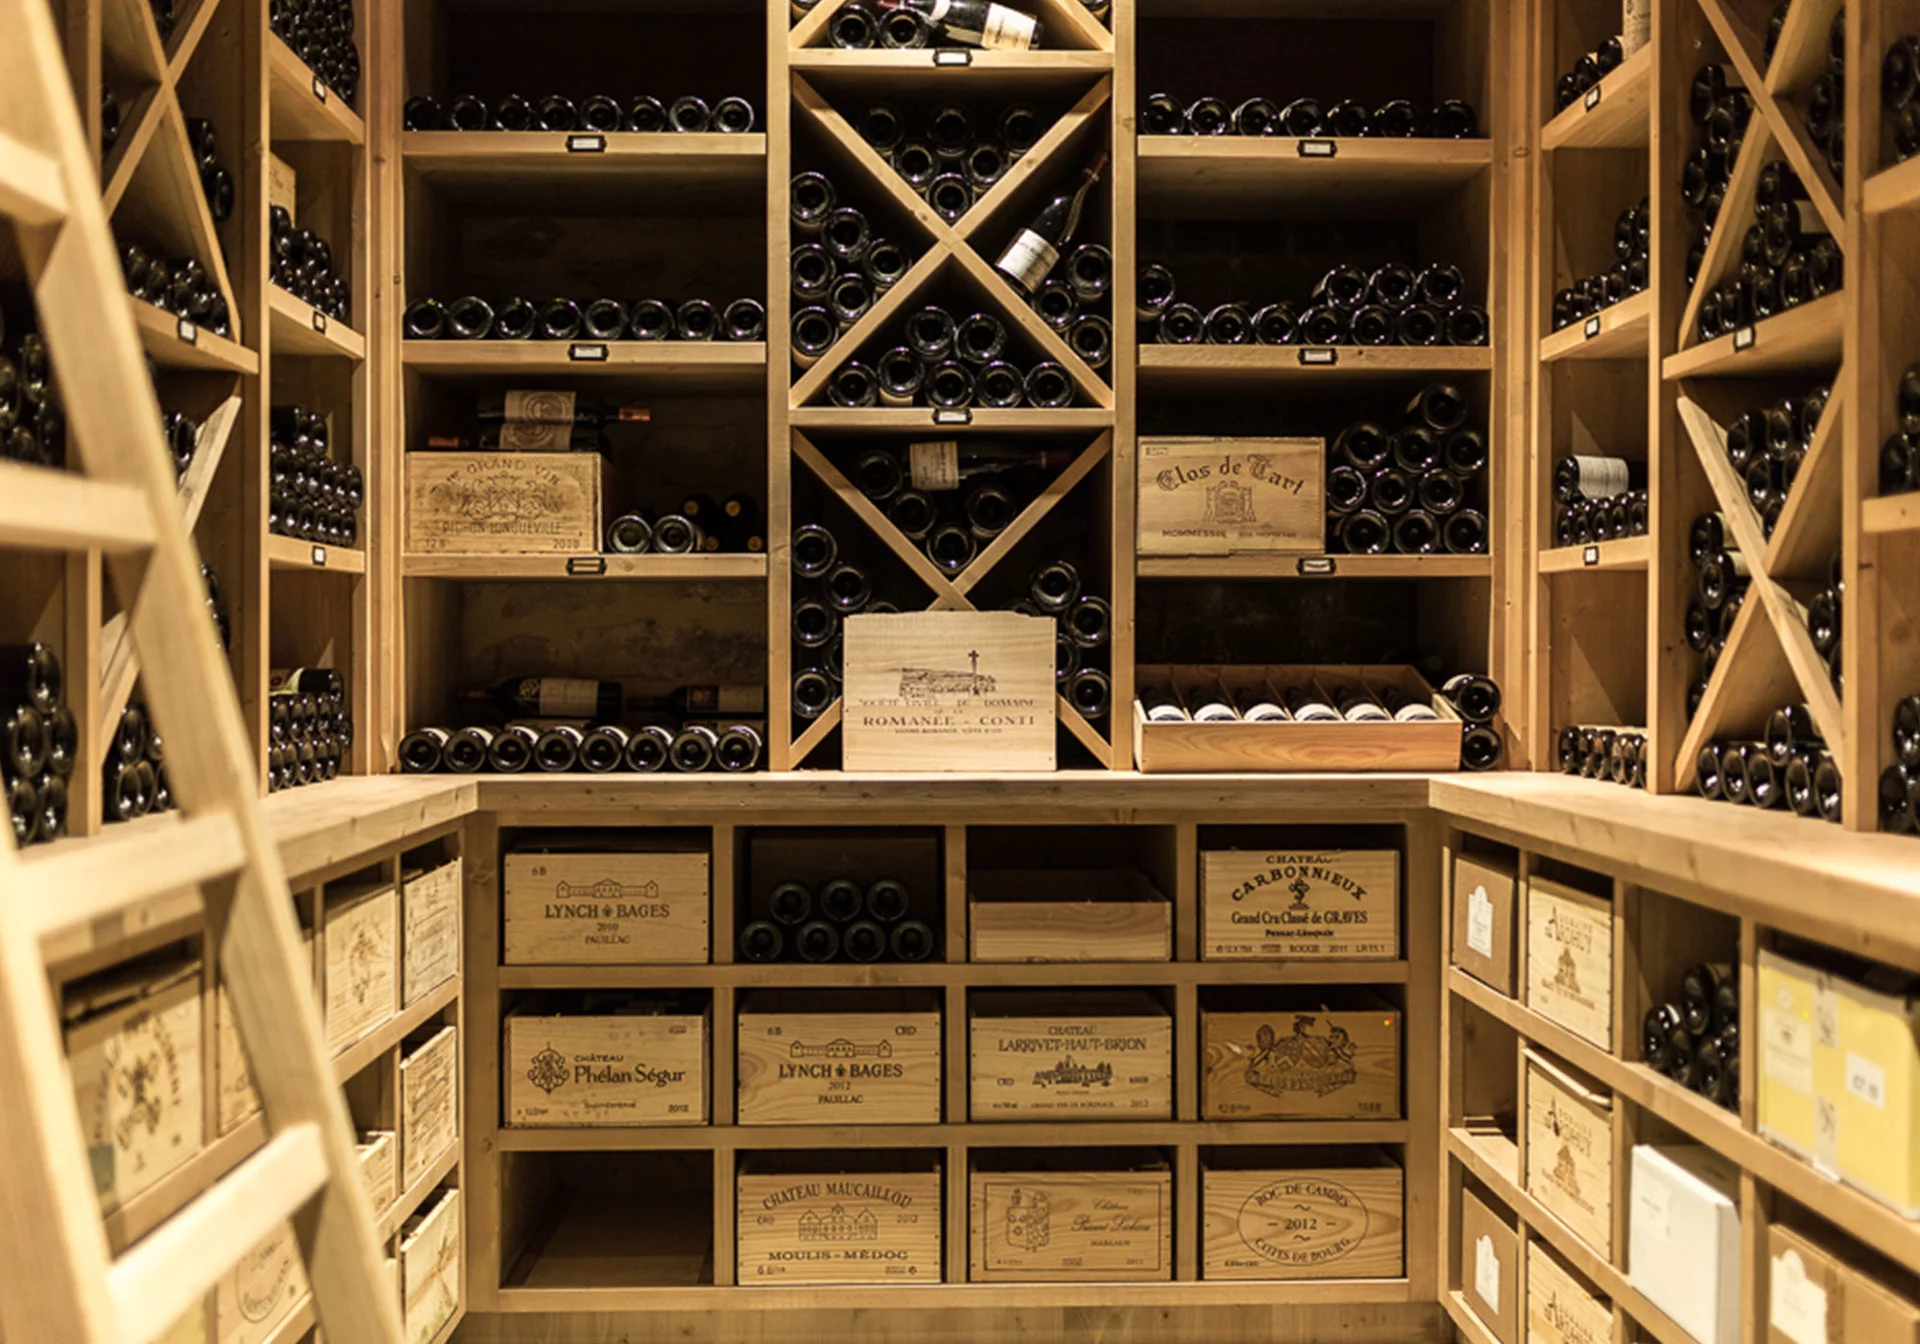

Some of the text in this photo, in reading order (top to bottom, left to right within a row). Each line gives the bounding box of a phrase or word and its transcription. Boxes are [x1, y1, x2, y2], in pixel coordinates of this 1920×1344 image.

[466, 459, 527, 475] GRAND
[534, 464, 562, 486] VIN
[1155, 463, 1212, 492] Clos
[1219, 455, 1242, 476] de
[979, 715, 1035, 726] CONTI
[1231, 865, 1369, 902] CARBONNIEUX
[545, 904, 671, 919] LYNCH BAGES
[1231, 911, 1261, 924] Grand
[1262, 911, 1280, 924] Cru
[1311, 911, 1323, 924] de
[1323, 911, 1369, 924] GRAVES
[585, 935, 630, 945] PAUILLAC
[573, 1063, 687, 1087] Phélan Ségur
[778, 1063, 904, 1078] LYNCH BAGES
[828, 1081, 851, 1091] 2012
[817, 1094, 864, 1104] PAUILLAC
[1284, 1184, 1300, 1194] DE
[762, 1182, 913, 1211] CHATEAU MAUCAILLOU
[1284, 1218, 1318, 1231] 2012
[768, 1250, 832, 1261] MOULIS
